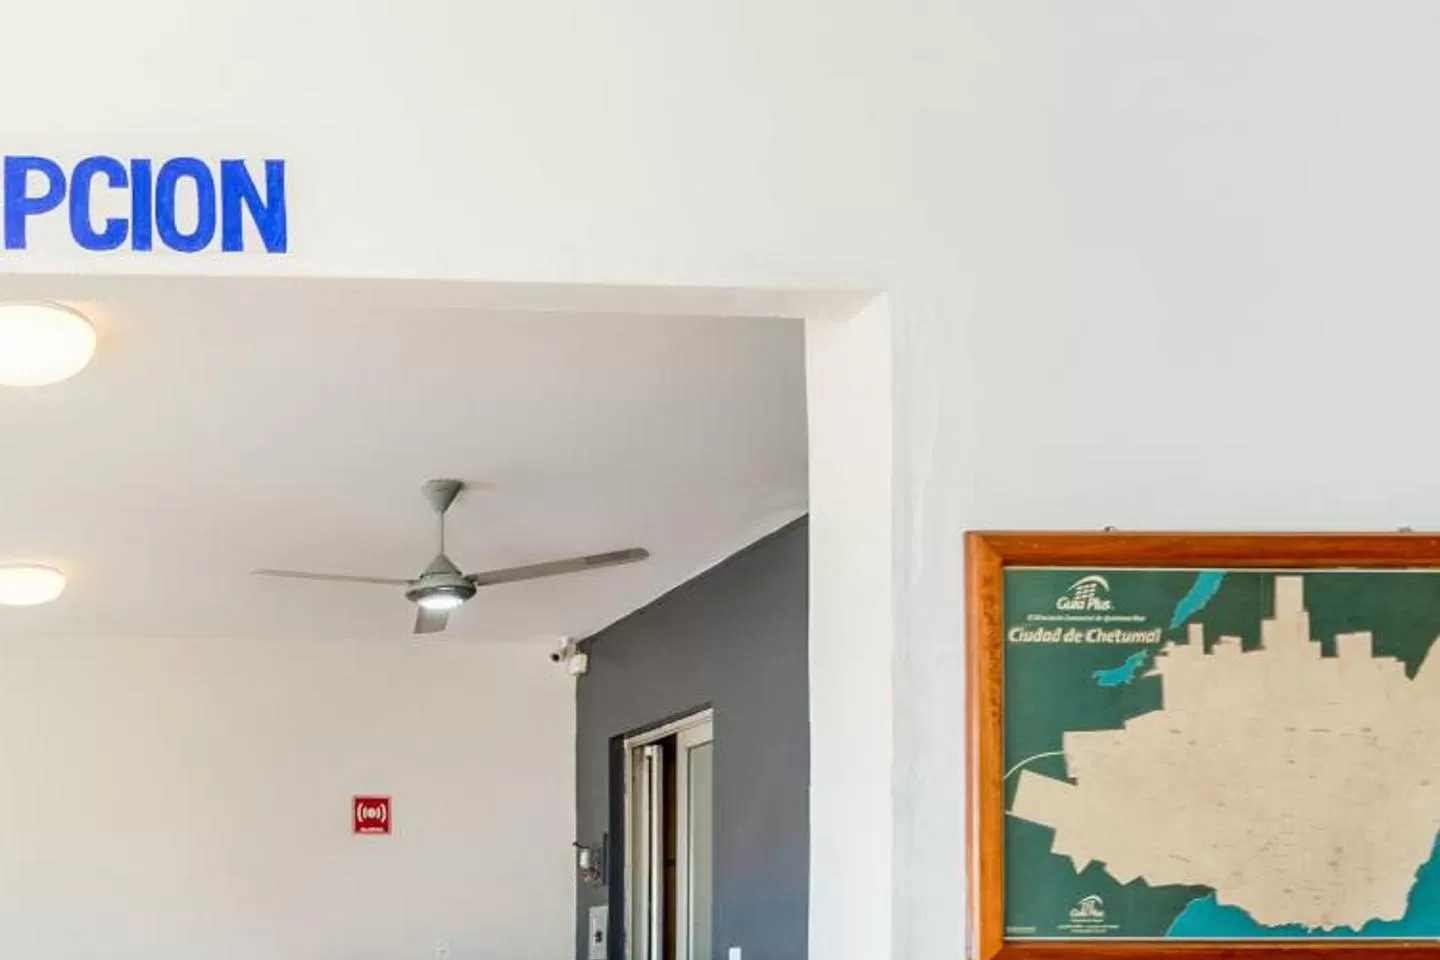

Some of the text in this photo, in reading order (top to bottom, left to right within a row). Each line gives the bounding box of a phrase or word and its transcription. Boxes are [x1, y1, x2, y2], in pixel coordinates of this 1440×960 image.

[1008, 626, 1162, 643] Ciudad de Chetumal
